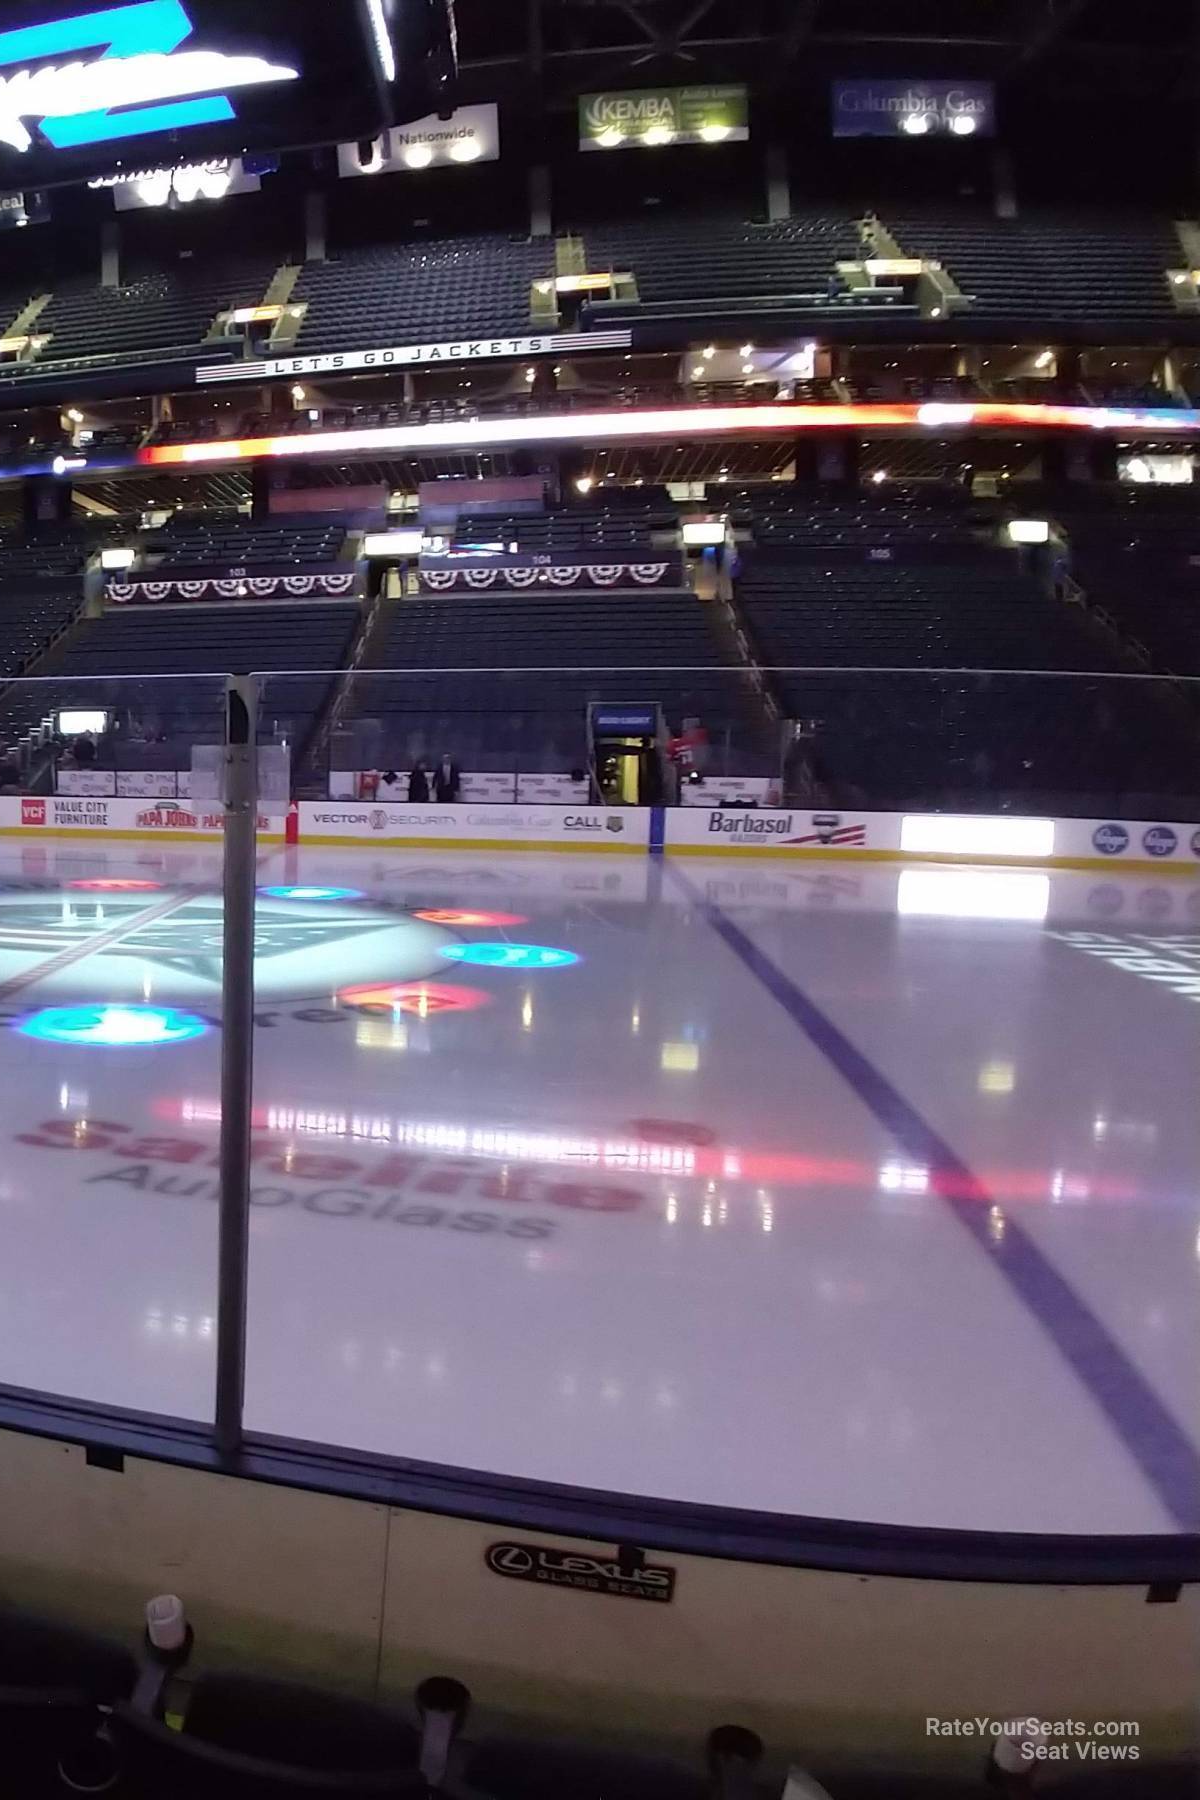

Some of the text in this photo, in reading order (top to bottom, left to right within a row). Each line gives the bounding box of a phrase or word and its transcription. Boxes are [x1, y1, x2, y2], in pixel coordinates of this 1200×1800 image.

[601, 97, 675, 121] KEMBA
[946, 90, 986, 113] Gas
[399, 126, 476, 145] Nationwide
[274, 338, 542, 373] LET'S GO JACKETS
[533, 555, 552, 564] 104
[22, 806, 45, 818] VCF
[54, 801, 108, 813] VALUE CITY
[54, 814, 108, 826] FURNITURE
[313, 814, 368, 825] VECTOR
[563, 815, 602, 827] CALL
[708, 812, 793, 834] Barbasol
[83, 1165, 557, 1239] AuoGlass
[538, 1552, 670, 1586] LEXUS
